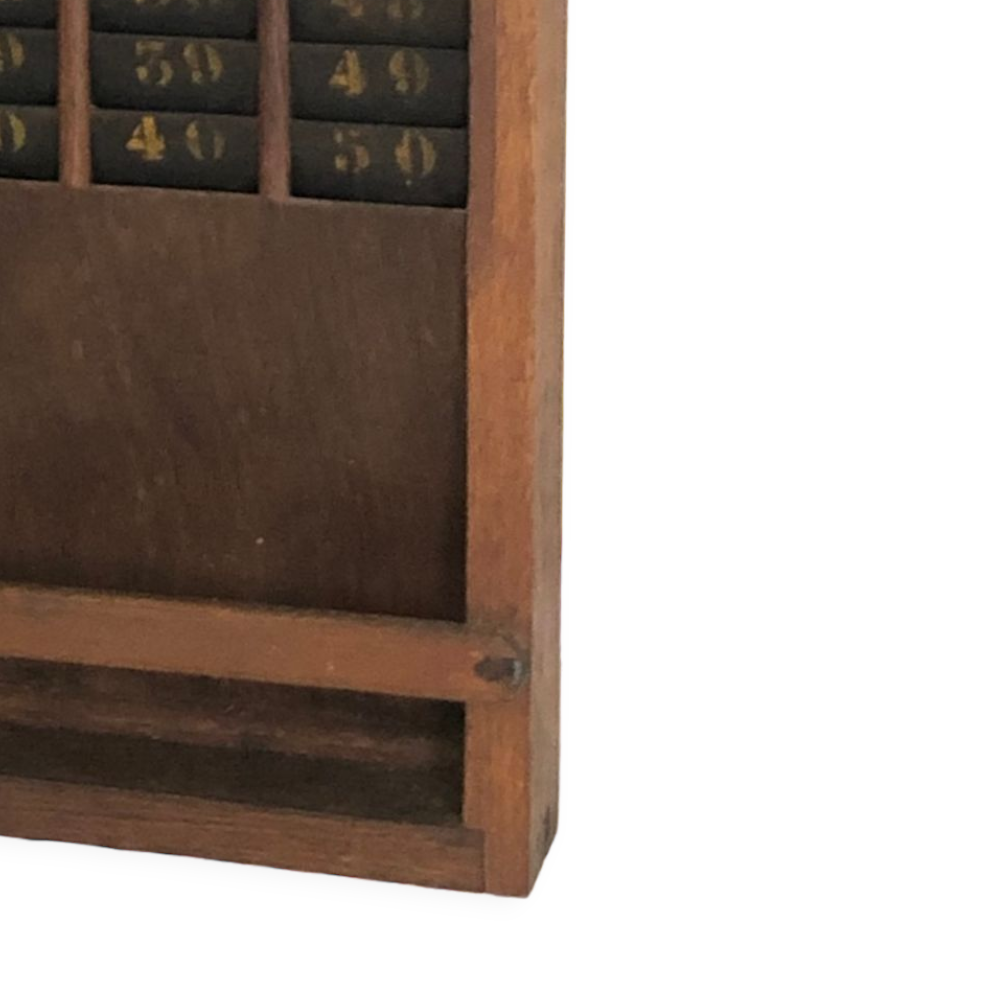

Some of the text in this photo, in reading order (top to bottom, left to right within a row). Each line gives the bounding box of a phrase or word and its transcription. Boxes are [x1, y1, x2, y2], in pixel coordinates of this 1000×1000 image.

[135, 41, 224, 87] 39
[125, 115, 226, 162] 40
[334, 128, 438, 177] 50
